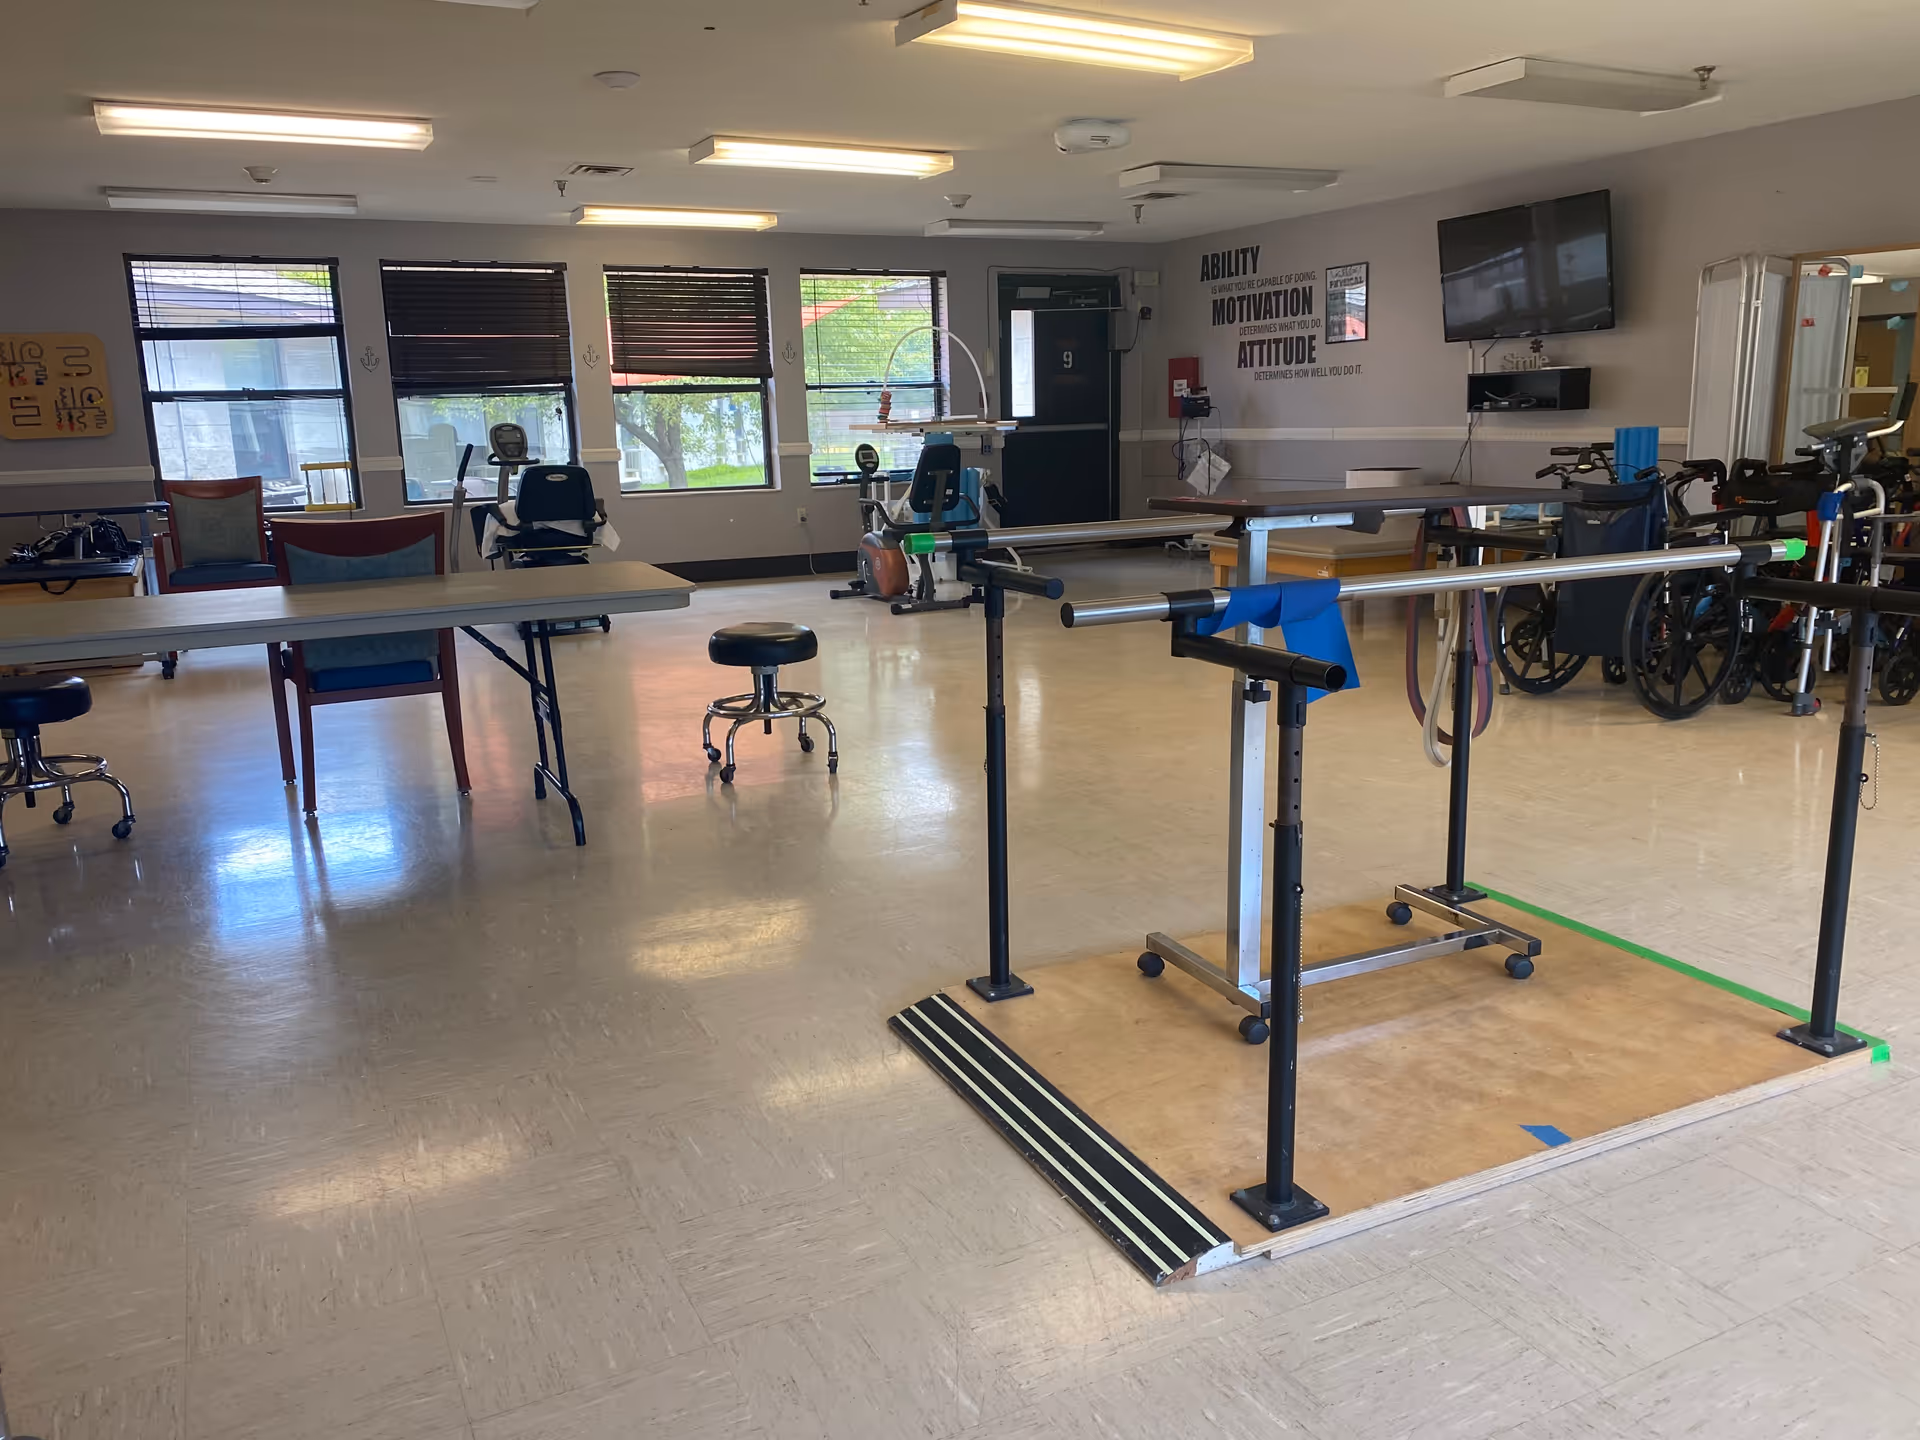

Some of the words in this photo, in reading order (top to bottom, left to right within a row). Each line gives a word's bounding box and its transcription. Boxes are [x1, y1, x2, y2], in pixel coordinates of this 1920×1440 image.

[1200, 245, 1260, 282] ABILITY
[1218, 279, 1234, 293] WHAT
[1256, 274, 1284, 289] CAPABLE
[1284, 273, 1293, 284] OF
[1294, 270, 1317, 283] DOING.
[1212, 285, 1313, 326] MOTIVATION
[1239, 323, 1278, 337] DETERMINES
[1278, 321, 1297, 332] WHAT
[1297, 319, 1310, 330] YOU
[1311, 318, 1323, 329] DO.
[1063, 351, 1073, 369] 9
[1237, 334, 1317, 369] ATTITUDE
[1503, 352, 1550, 371] Smile
[1254, 369, 1293, 381] DETERMINES
[1294, 368, 1310, 378] HOW
[1311, 367, 1328, 377] WELL
[1328, 366, 1343, 376] YOU
[1343, 365, 1355, 376] DO
[1355, 364, 1363, 374] IT.
